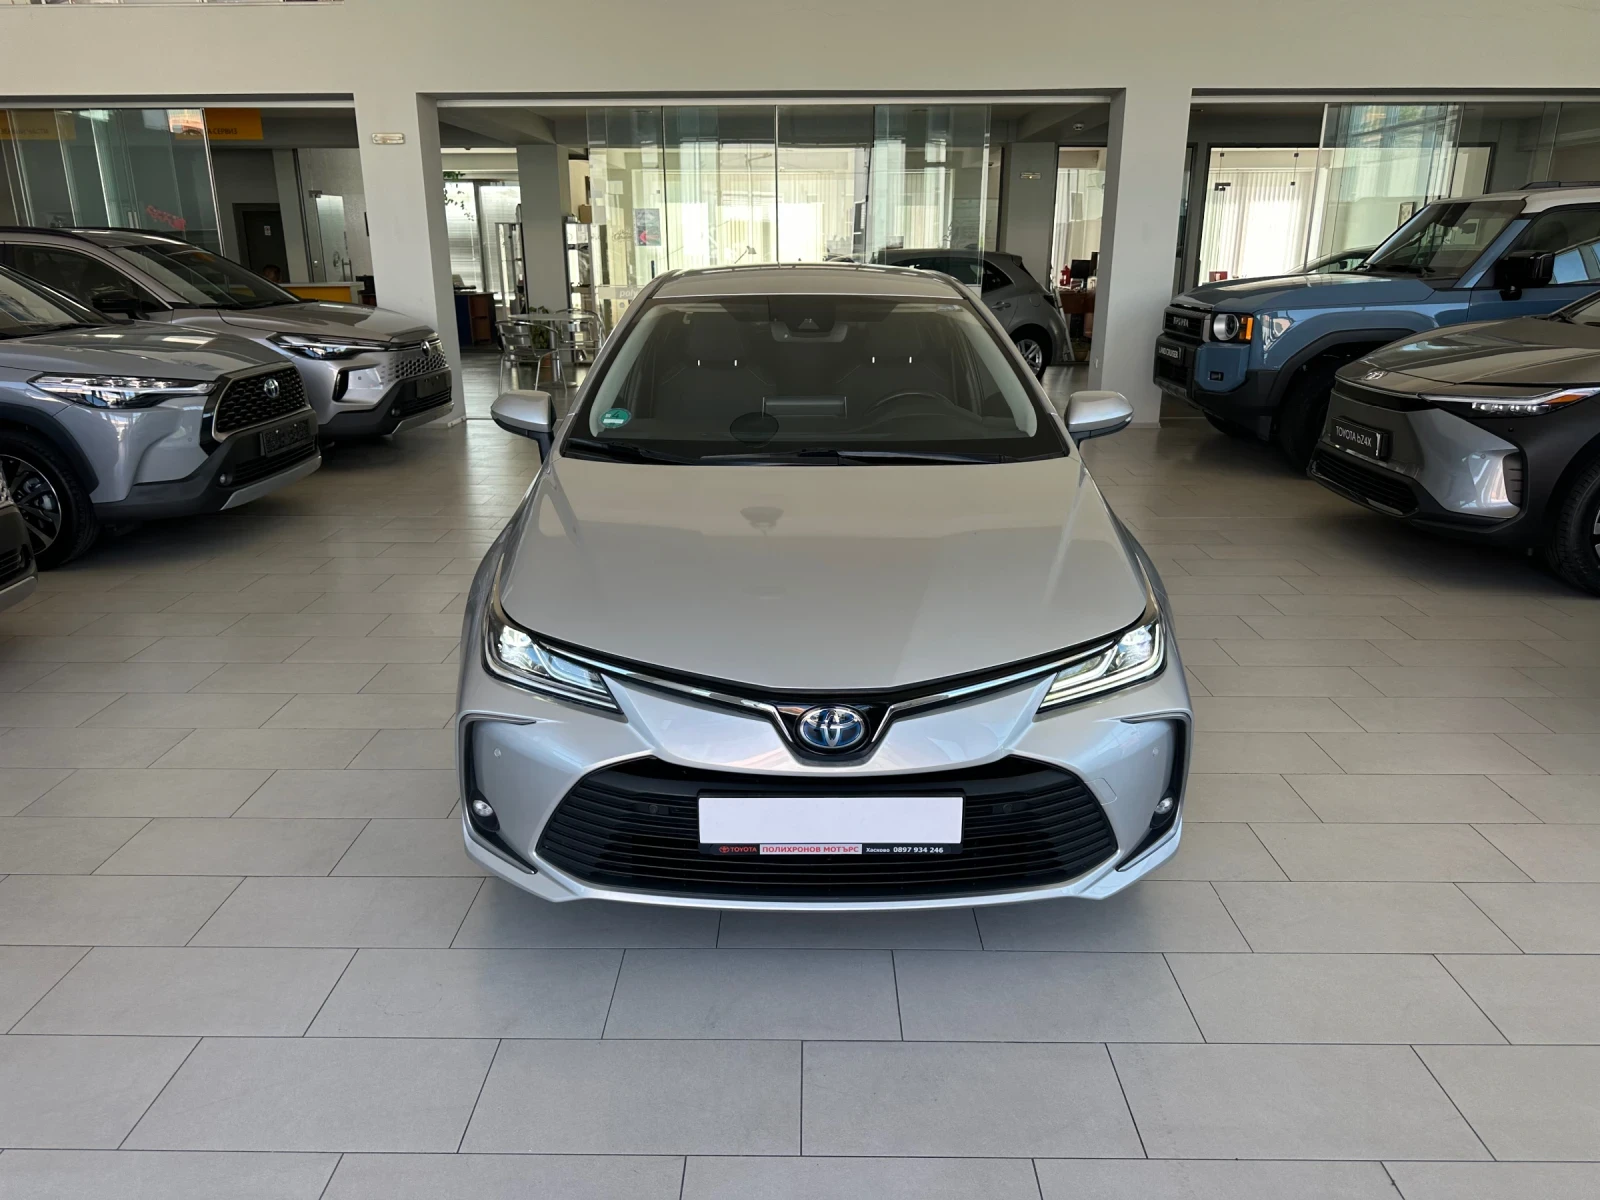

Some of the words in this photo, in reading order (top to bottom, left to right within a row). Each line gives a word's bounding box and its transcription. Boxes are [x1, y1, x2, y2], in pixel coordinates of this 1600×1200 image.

[1335, 425, 1356, 442] TOYOTA
[1356, 432, 1372, 448] bZ4X
[762, 845, 821, 853] ПОЛИХРОНОВ
[823, 845, 859, 853] МОТЪРС
